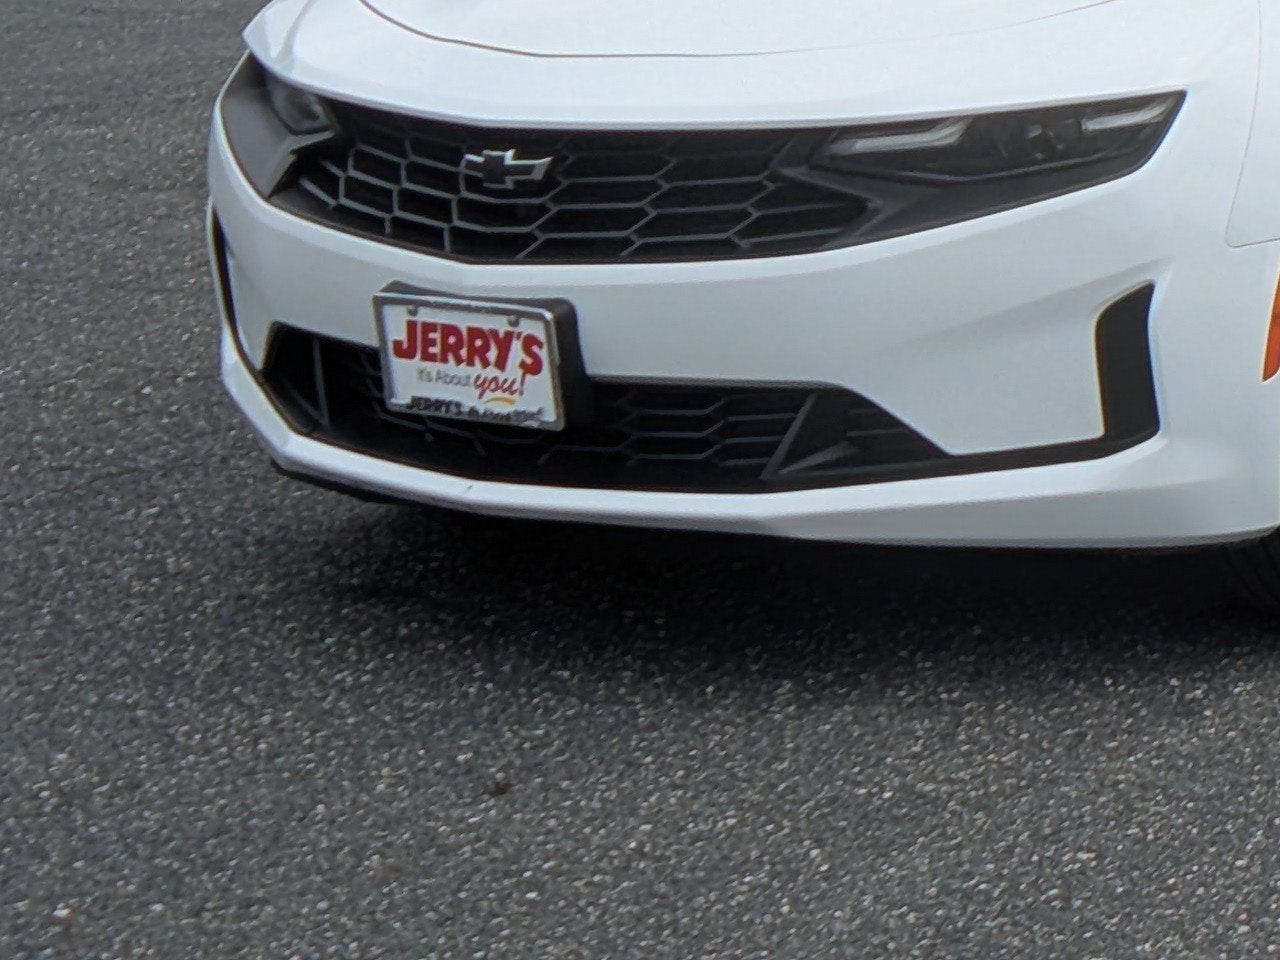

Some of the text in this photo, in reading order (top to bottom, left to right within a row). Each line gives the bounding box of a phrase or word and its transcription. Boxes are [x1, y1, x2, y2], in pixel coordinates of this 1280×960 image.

[393, 319, 544, 376] JERRY'S
[435, 369, 472, 387] About
[473, 371, 526, 399] you!
